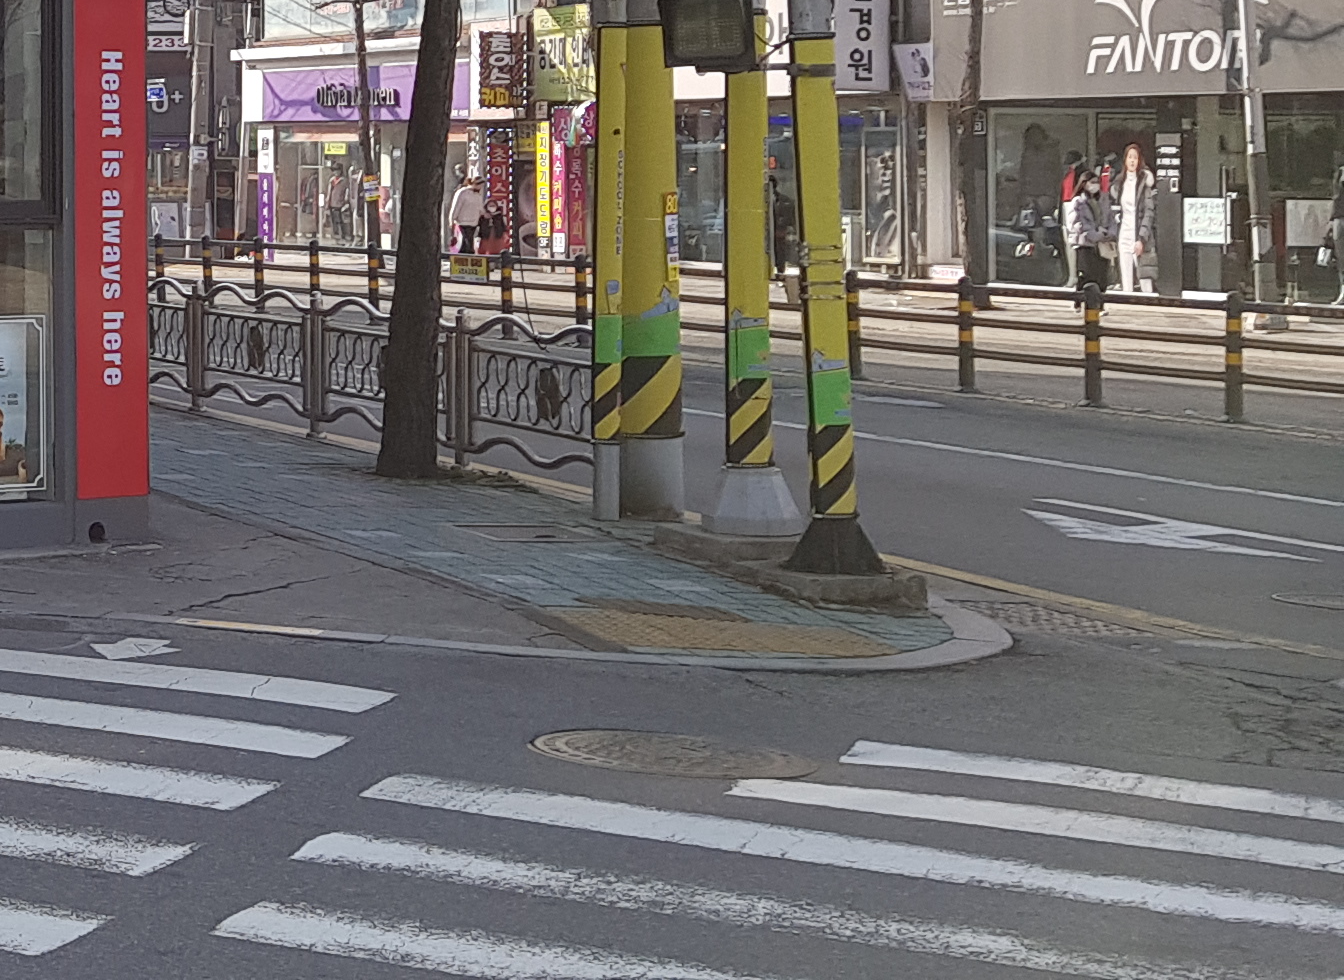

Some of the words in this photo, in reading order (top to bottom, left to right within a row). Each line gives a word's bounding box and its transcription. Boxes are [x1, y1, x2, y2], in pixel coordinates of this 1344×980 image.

[101, 51, 124, 137] Heart
[316, 84, 348, 107] Olivia
[351, 86, 395, 107] Lren
[101, 148, 124, 179] is
[101, 189, 124, 300] always
[102, 311, 124, 387] here
